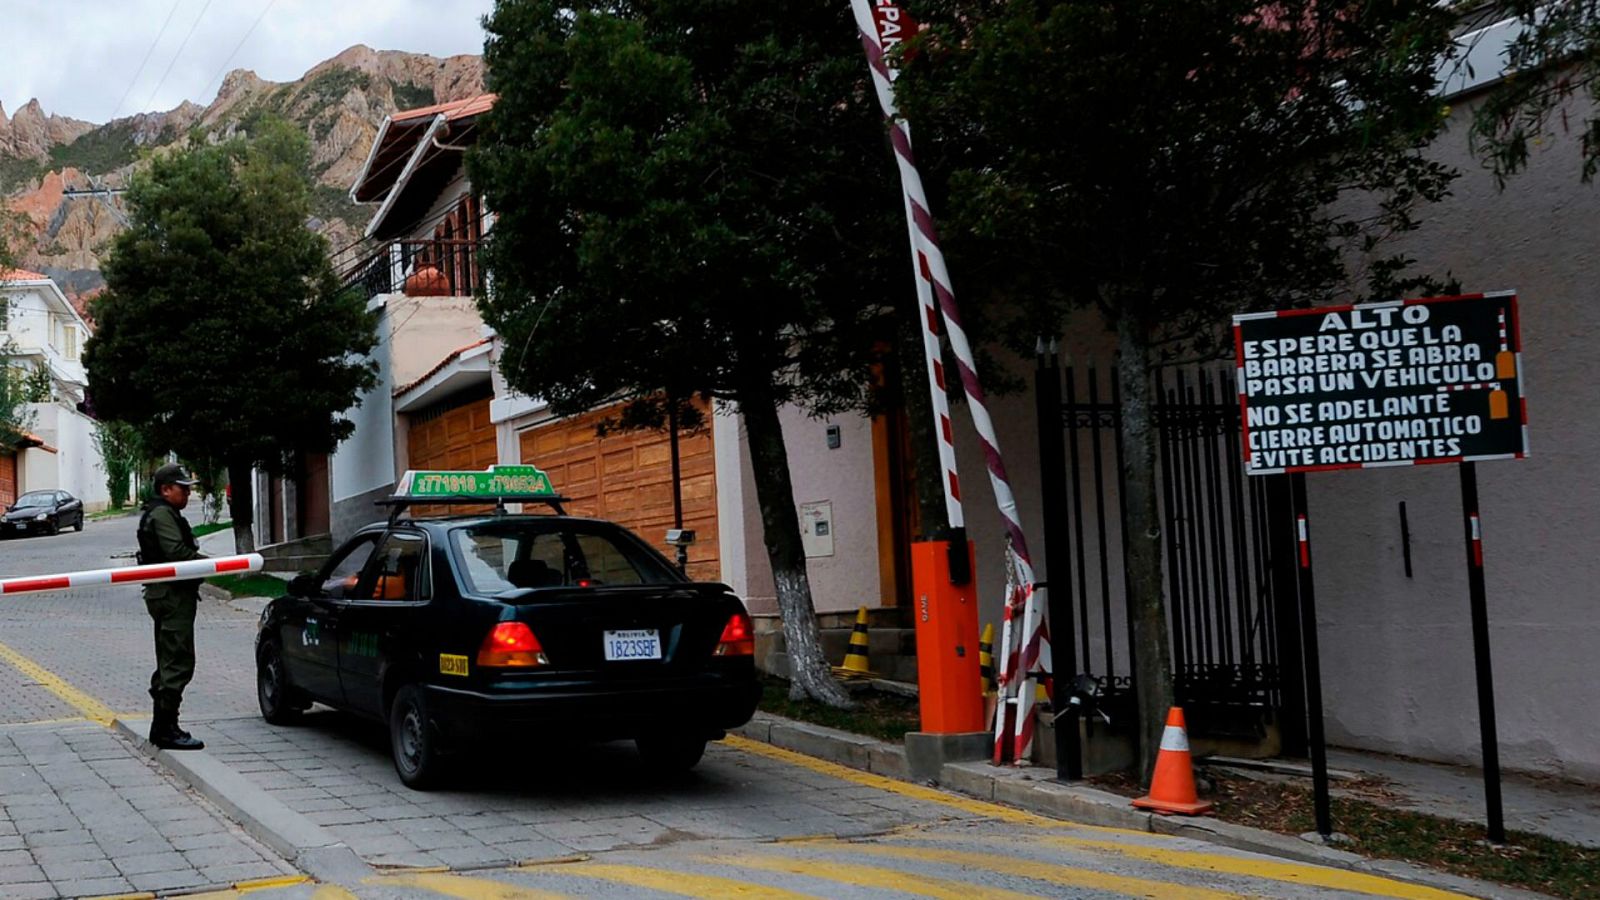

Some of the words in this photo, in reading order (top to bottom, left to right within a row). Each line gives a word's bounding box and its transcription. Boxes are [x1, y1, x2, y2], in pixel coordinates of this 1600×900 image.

[1319, 305, 1430, 332] ALTO
[1244, 333, 1355, 359] ESPERE
[1359, 328, 1419, 350] QUE
[1423, 325, 1462, 344] LA
[1245, 351, 1366, 378] BARRERA
[1371, 347, 1402, 368] SE
[1409, 343, 1481, 366] ABRA
[1247, 376, 1315, 397] PASA
[1319, 372, 1354, 393] UN
[1359, 362, 1495, 389] VEHICULO
[1247, 405, 1281, 428] NO
[1286, 403, 1313, 425] SE
[1318, 393, 1451, 421] ADELANTE
[1248, 426, 1325, 450] CIERRE
[1329, 415, 1482, 443] AUTOMATICO
[1250, 448, 1315, 469] EVITE
[1320, 437, 1461, 464] ACCIDENTES
